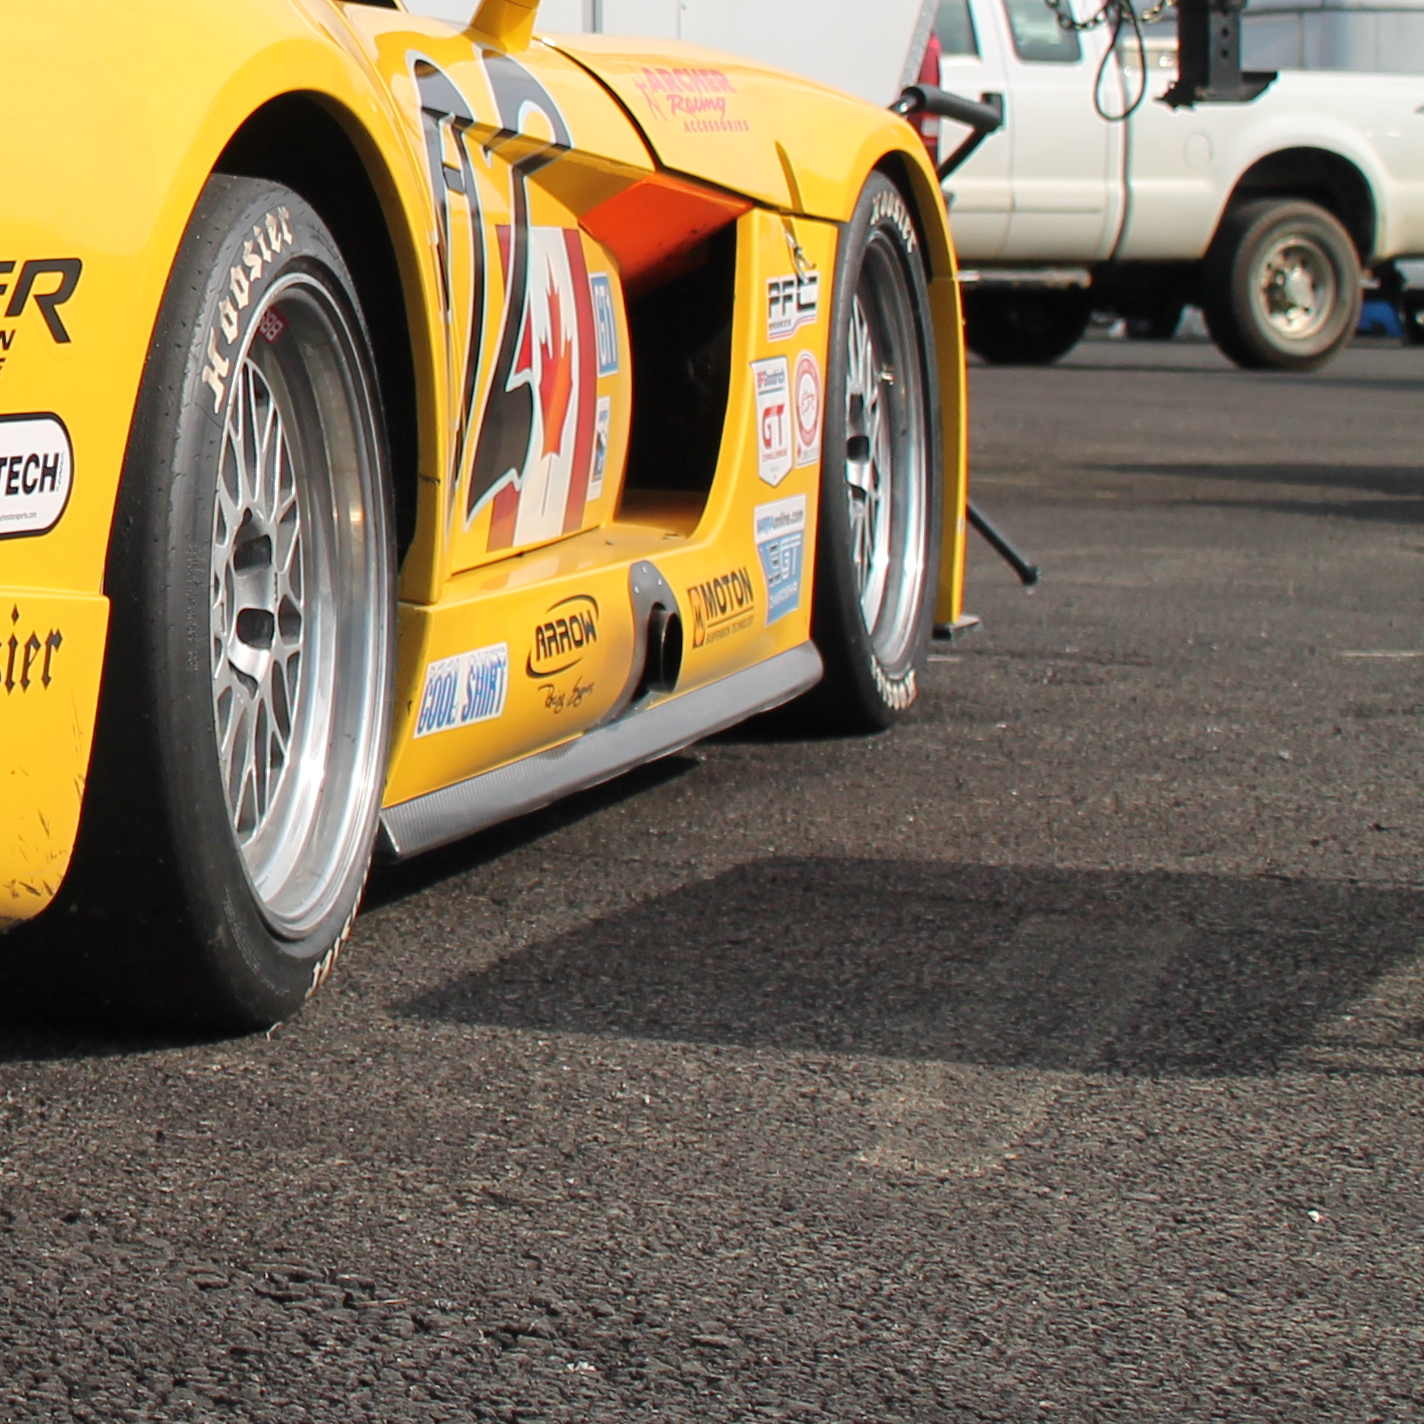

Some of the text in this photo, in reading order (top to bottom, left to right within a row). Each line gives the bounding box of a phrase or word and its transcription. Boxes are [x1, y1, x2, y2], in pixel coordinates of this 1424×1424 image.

[641, 67, 737, 93] ARCHER
[683, 119, 751, 133] ACCESSORIES
[202, 206, 293, 414] Hoosier
[767, 275, 818, 319] PFC
[761, 403, 785, 449] GT
[699, 565, 755, 622] MOTON
[535, 609, 598, 663] ARROW
[417, 668, 458, 735] COOL
[460, 656, 507, 723] SHIRT
